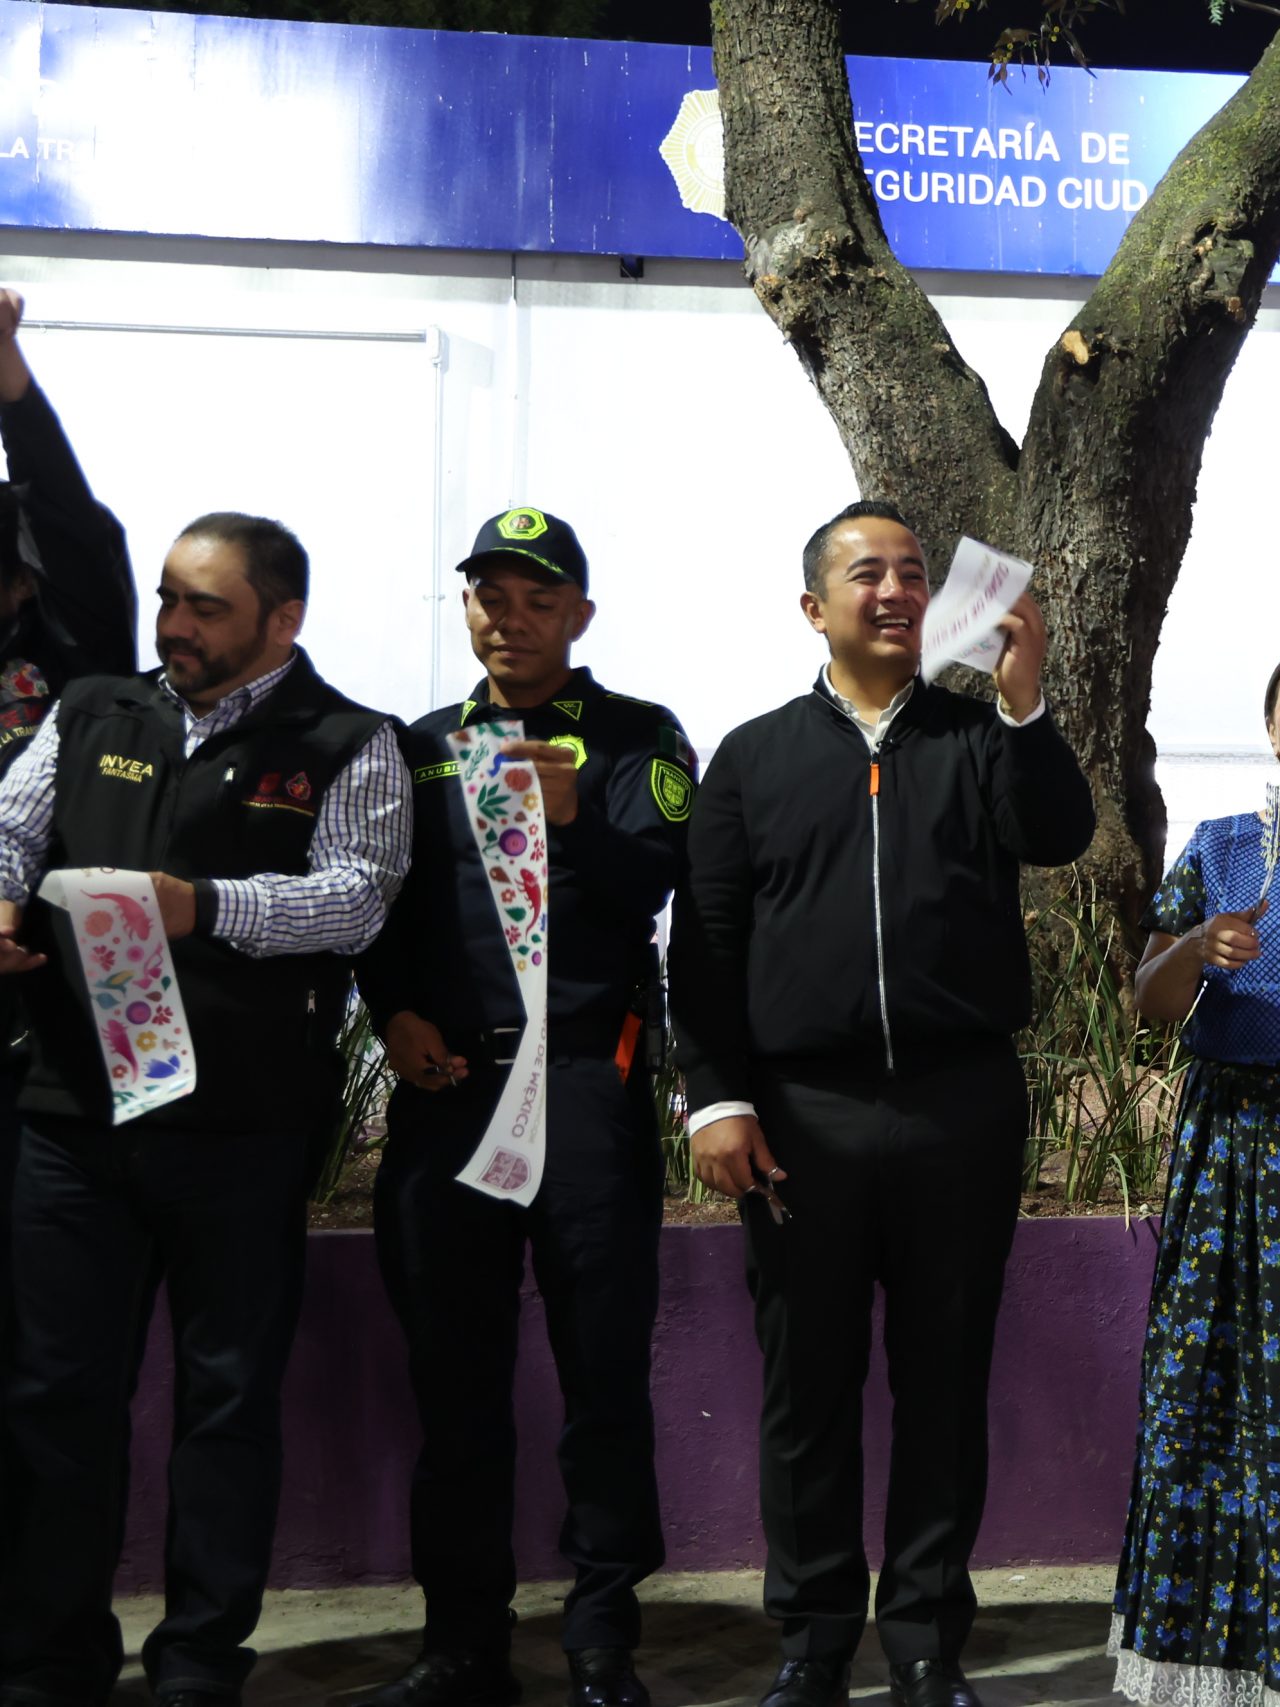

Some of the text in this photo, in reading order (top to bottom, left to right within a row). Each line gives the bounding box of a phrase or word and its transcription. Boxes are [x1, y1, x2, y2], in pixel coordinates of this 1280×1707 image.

[853, 121, 1130, 165] ECRETARÍA DE
[863, 168, 1148, 212] GURIDAD CIUD
[99, 754, 154, 777] INVEA
[102, 767, 142, 783] FANTASMA
